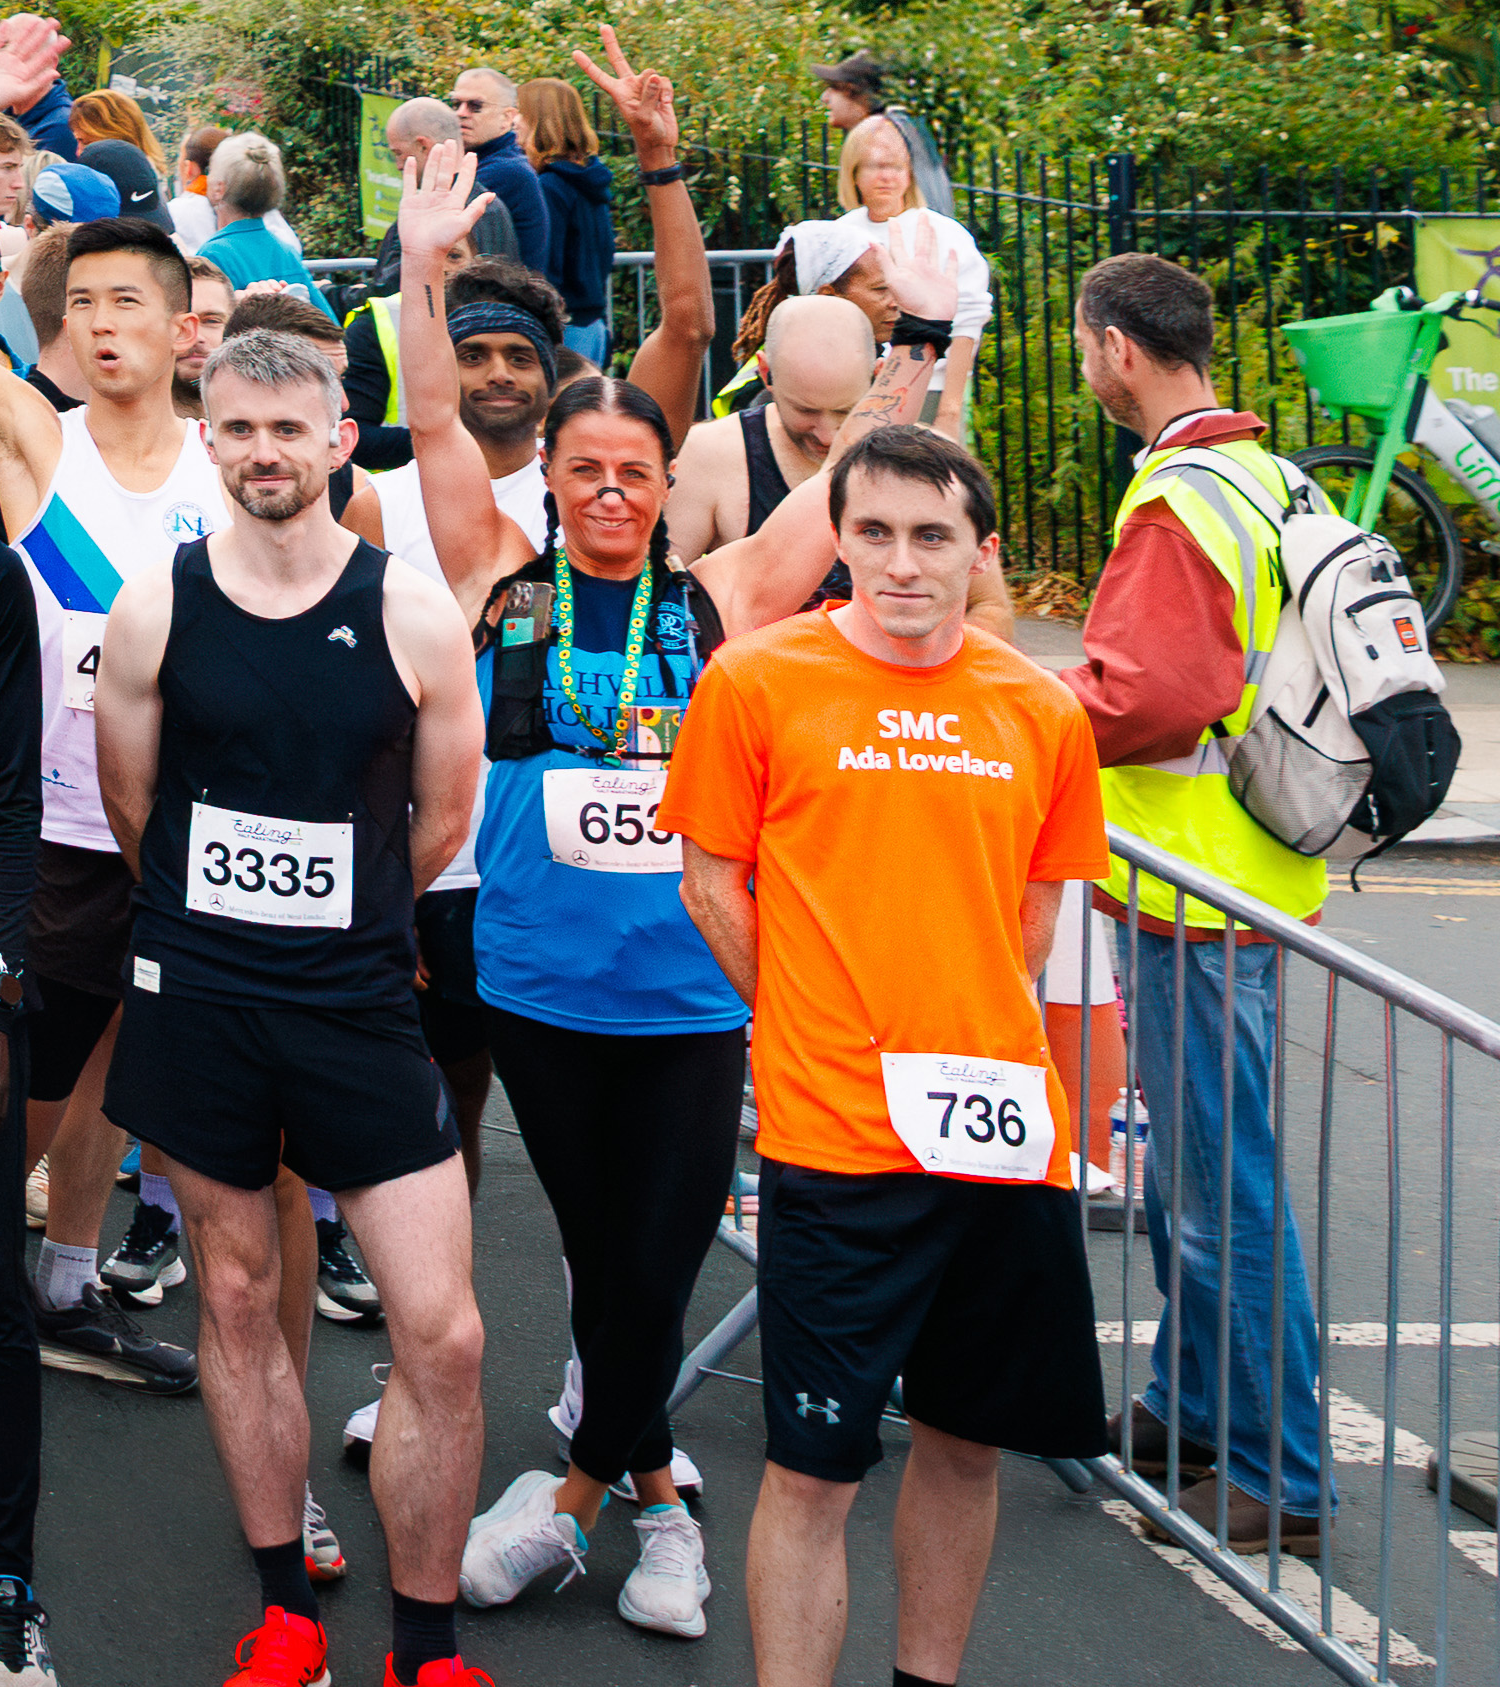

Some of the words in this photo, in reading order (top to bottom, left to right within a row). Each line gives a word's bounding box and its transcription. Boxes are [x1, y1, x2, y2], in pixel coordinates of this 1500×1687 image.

[1445, 365, 1499, 392] The
[878, 709, 961, 744] SMC
[838, 746, 892, 770] Ada
[898, 749, 1015, 781] Lovelace
[588, 776, 658, 796] Ealing
[232, 819, 304, 845] Ealing
[203, 841, 334, 899] 3335
[926, 1092, 1026, 1147] 736
